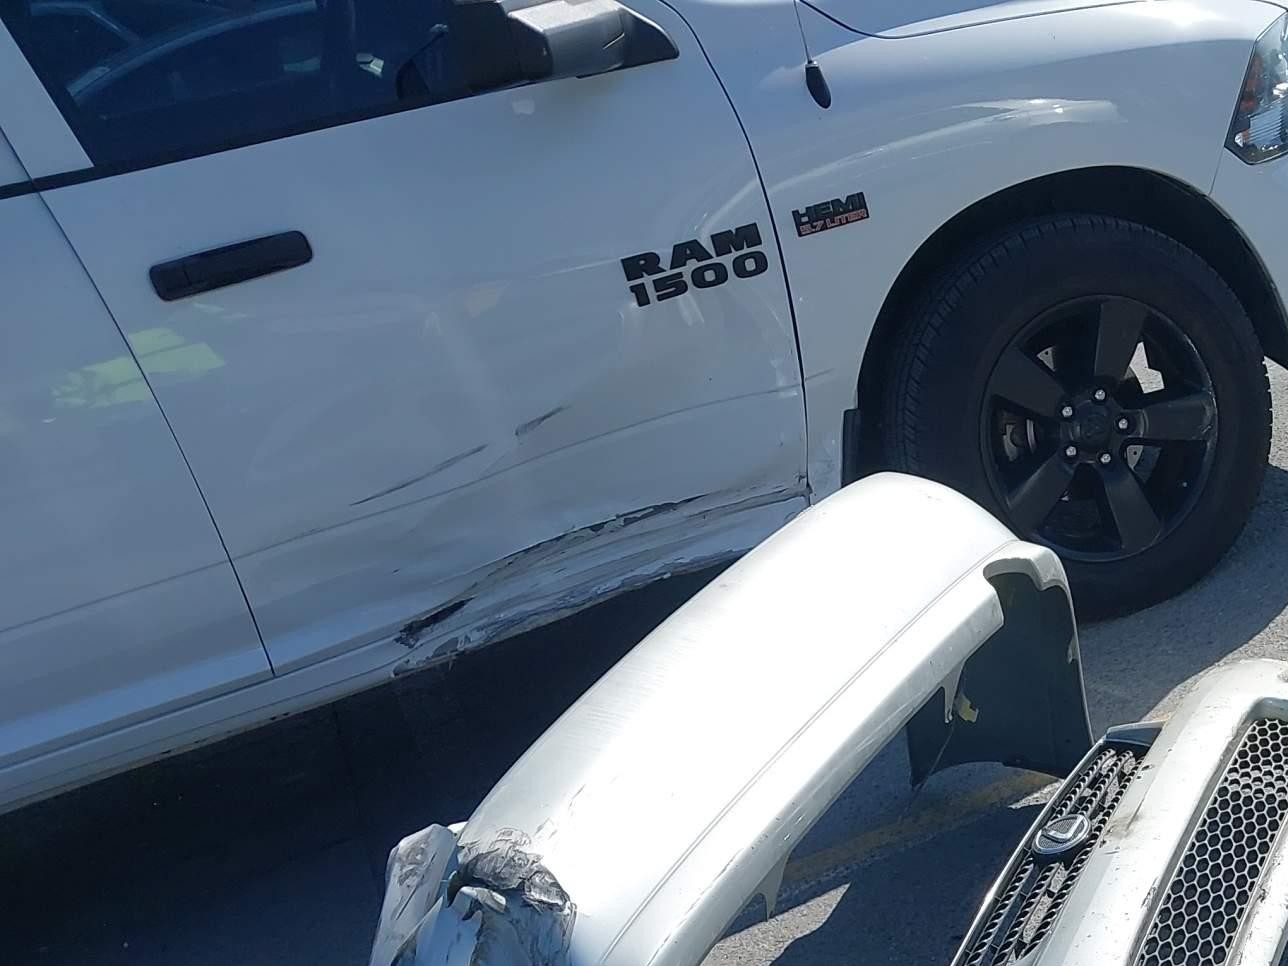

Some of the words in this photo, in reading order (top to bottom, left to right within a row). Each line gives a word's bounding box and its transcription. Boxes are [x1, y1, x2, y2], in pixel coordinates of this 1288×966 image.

[792, 192, 867, 222] HEMI
[826, 208, 867, 228] LITER
[620, 222, 763, 281] RAM
[630, 251, 768, 307] 1500
